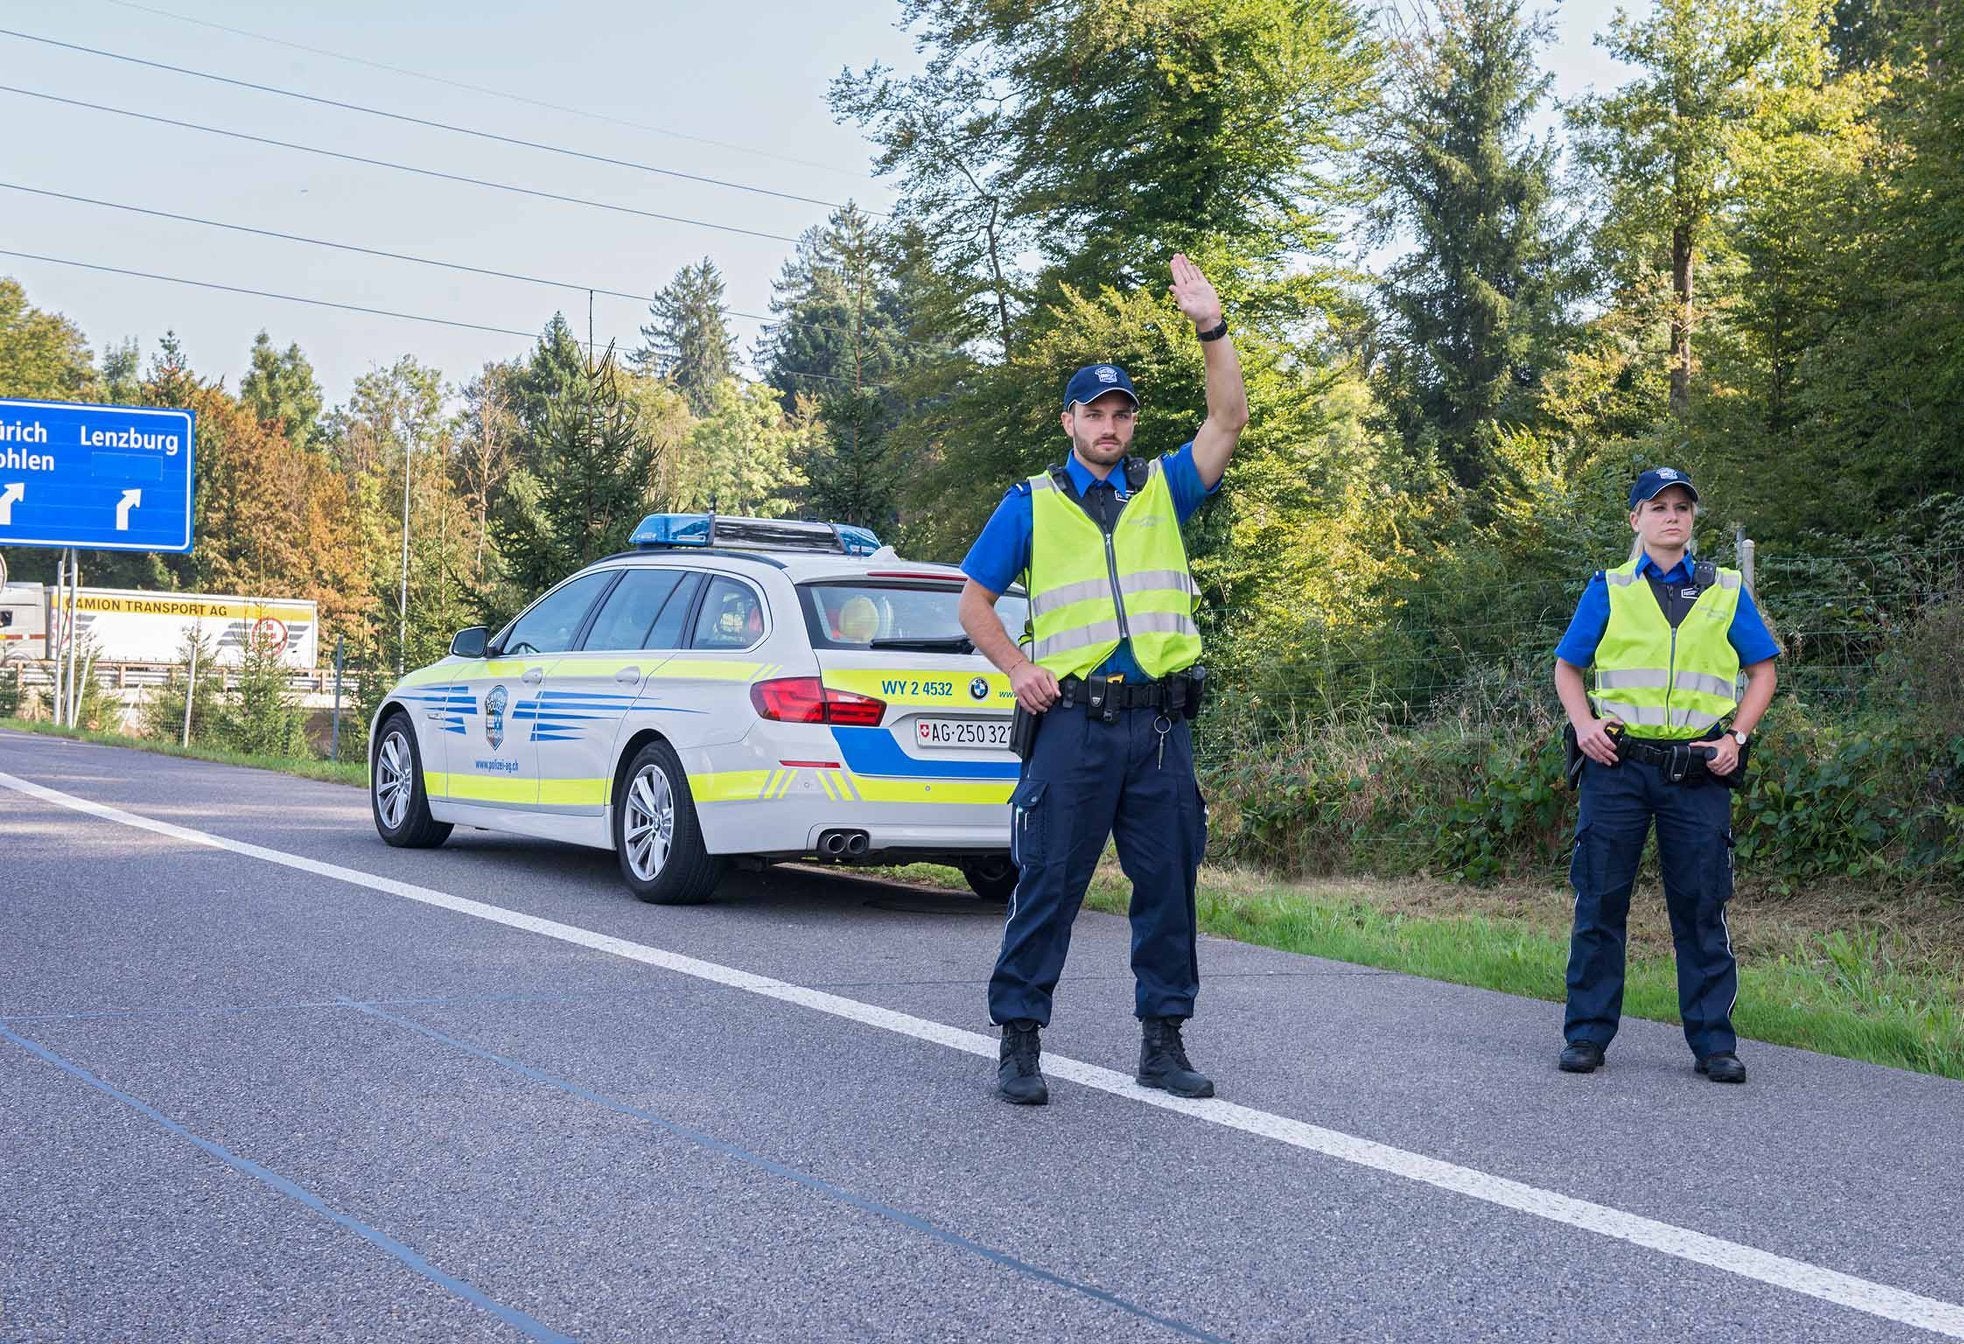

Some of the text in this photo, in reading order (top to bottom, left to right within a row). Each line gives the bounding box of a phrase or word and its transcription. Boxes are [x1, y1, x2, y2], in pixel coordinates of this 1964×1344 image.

[80, 425, 179, 456] Lenzburg
[126, 600, 206, 616] TRANSPORT
[210, 605, 228, 617] AG
[881, 680, 907, 695] WY
[911, 681, 919, 696] 2
[922, 681, 953, 697] 4532
[475, 759, 519, 773] www.polizei-ag.ch
